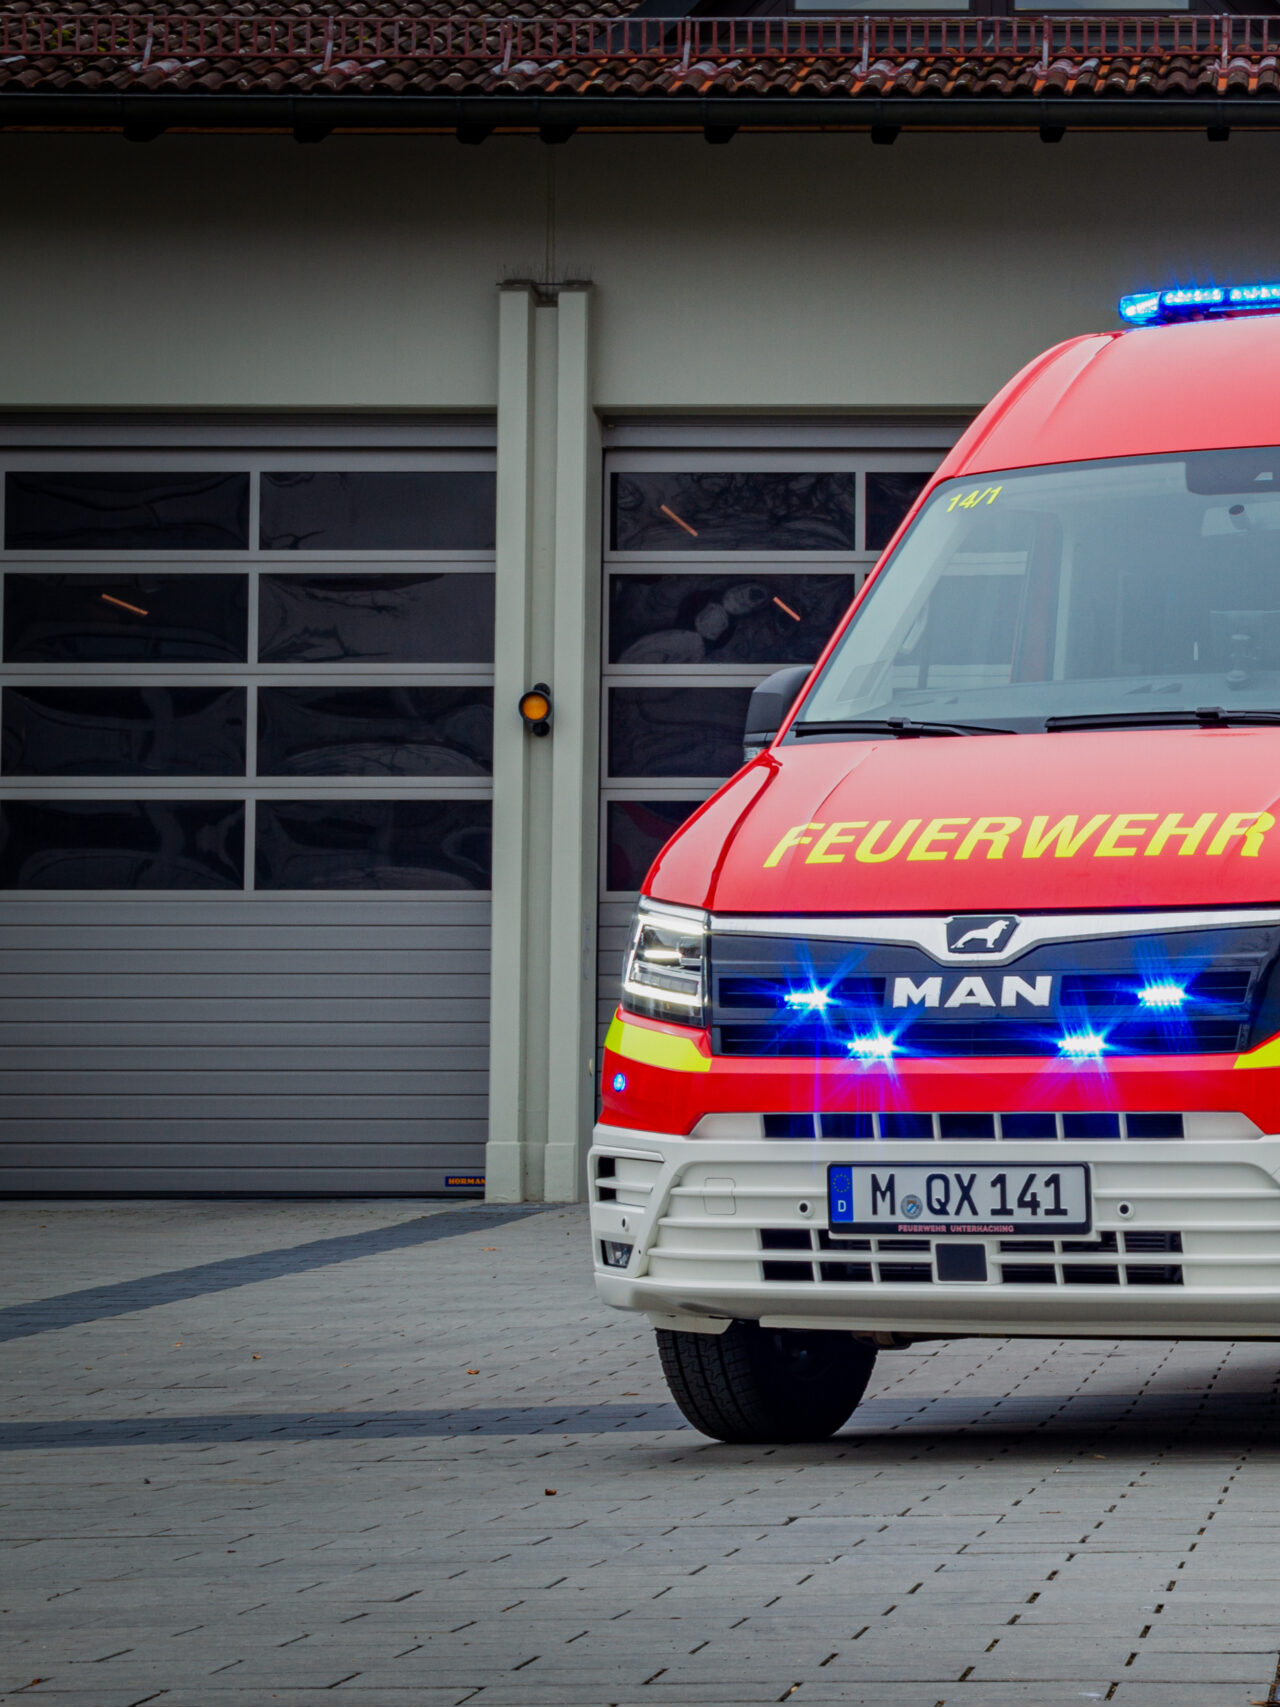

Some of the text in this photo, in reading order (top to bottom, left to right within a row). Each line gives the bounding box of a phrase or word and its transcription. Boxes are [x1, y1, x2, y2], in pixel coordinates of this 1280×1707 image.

[946, 485, 1003, 513] 14/1
[763, 812, 1276, 868] FEUERWEHR
[892, 975, 1052, 1008] MAN
[837, 1200, 847, 1213] D
[871, 1173, 1068, 1216] M QX 141
[898, 1224, 1014, 1233] FEUERWEHR UNTERHACHING
